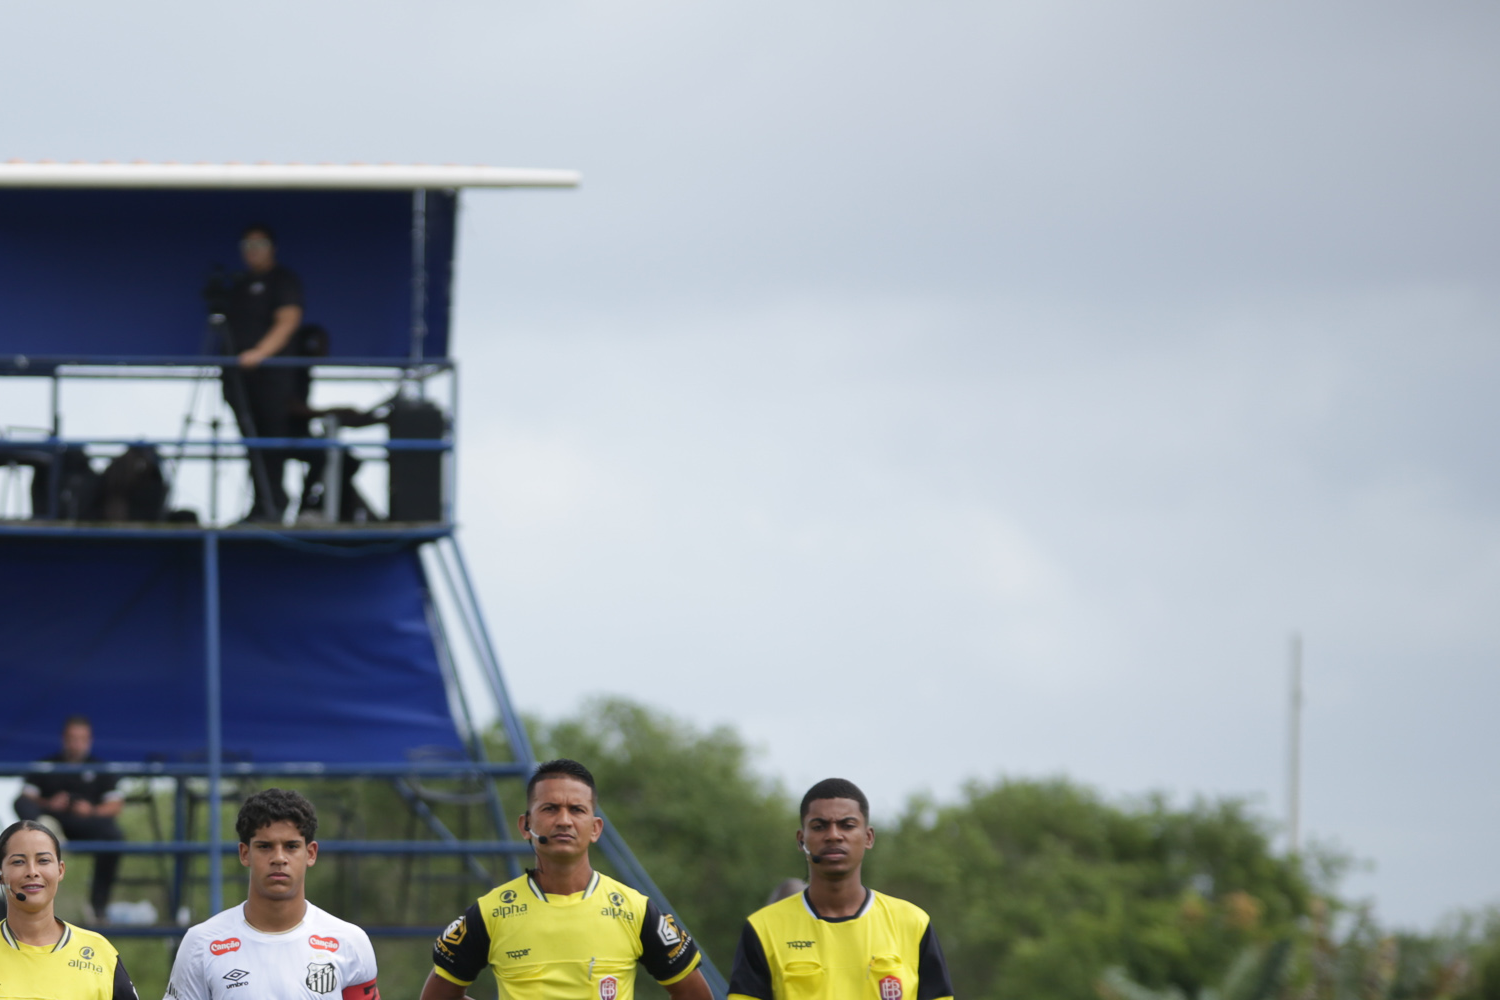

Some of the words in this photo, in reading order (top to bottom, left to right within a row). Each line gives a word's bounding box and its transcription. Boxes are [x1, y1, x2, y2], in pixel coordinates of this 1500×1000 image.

[210, 940, 241, 953] Canção
[309, 936, 339, 950] Canção
[225, 980, 250, 990] umbro
